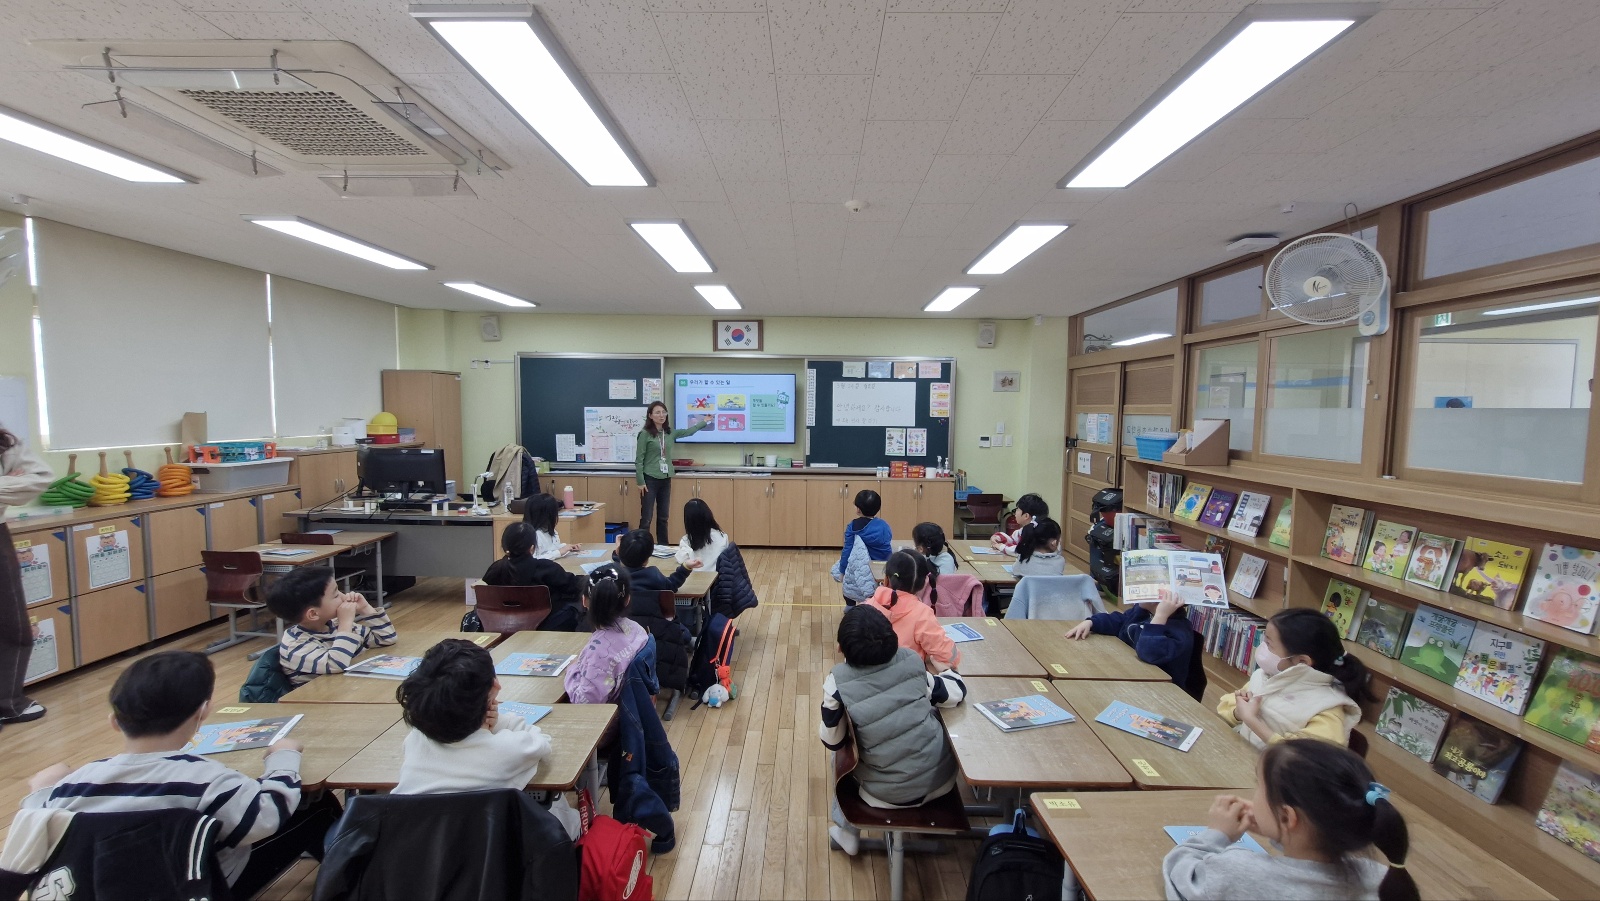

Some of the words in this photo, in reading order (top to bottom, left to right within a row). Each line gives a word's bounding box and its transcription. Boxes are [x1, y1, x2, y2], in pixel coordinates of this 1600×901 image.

[836, 403, 871, 412] 안녕하세요?
[875, 404, 902, 413] 감사합니다
[1489, 638, 1513, 650] 지구를
[1493, 651, 1506, 660] 위한
[1450, 746, 1464, 757] 내가
